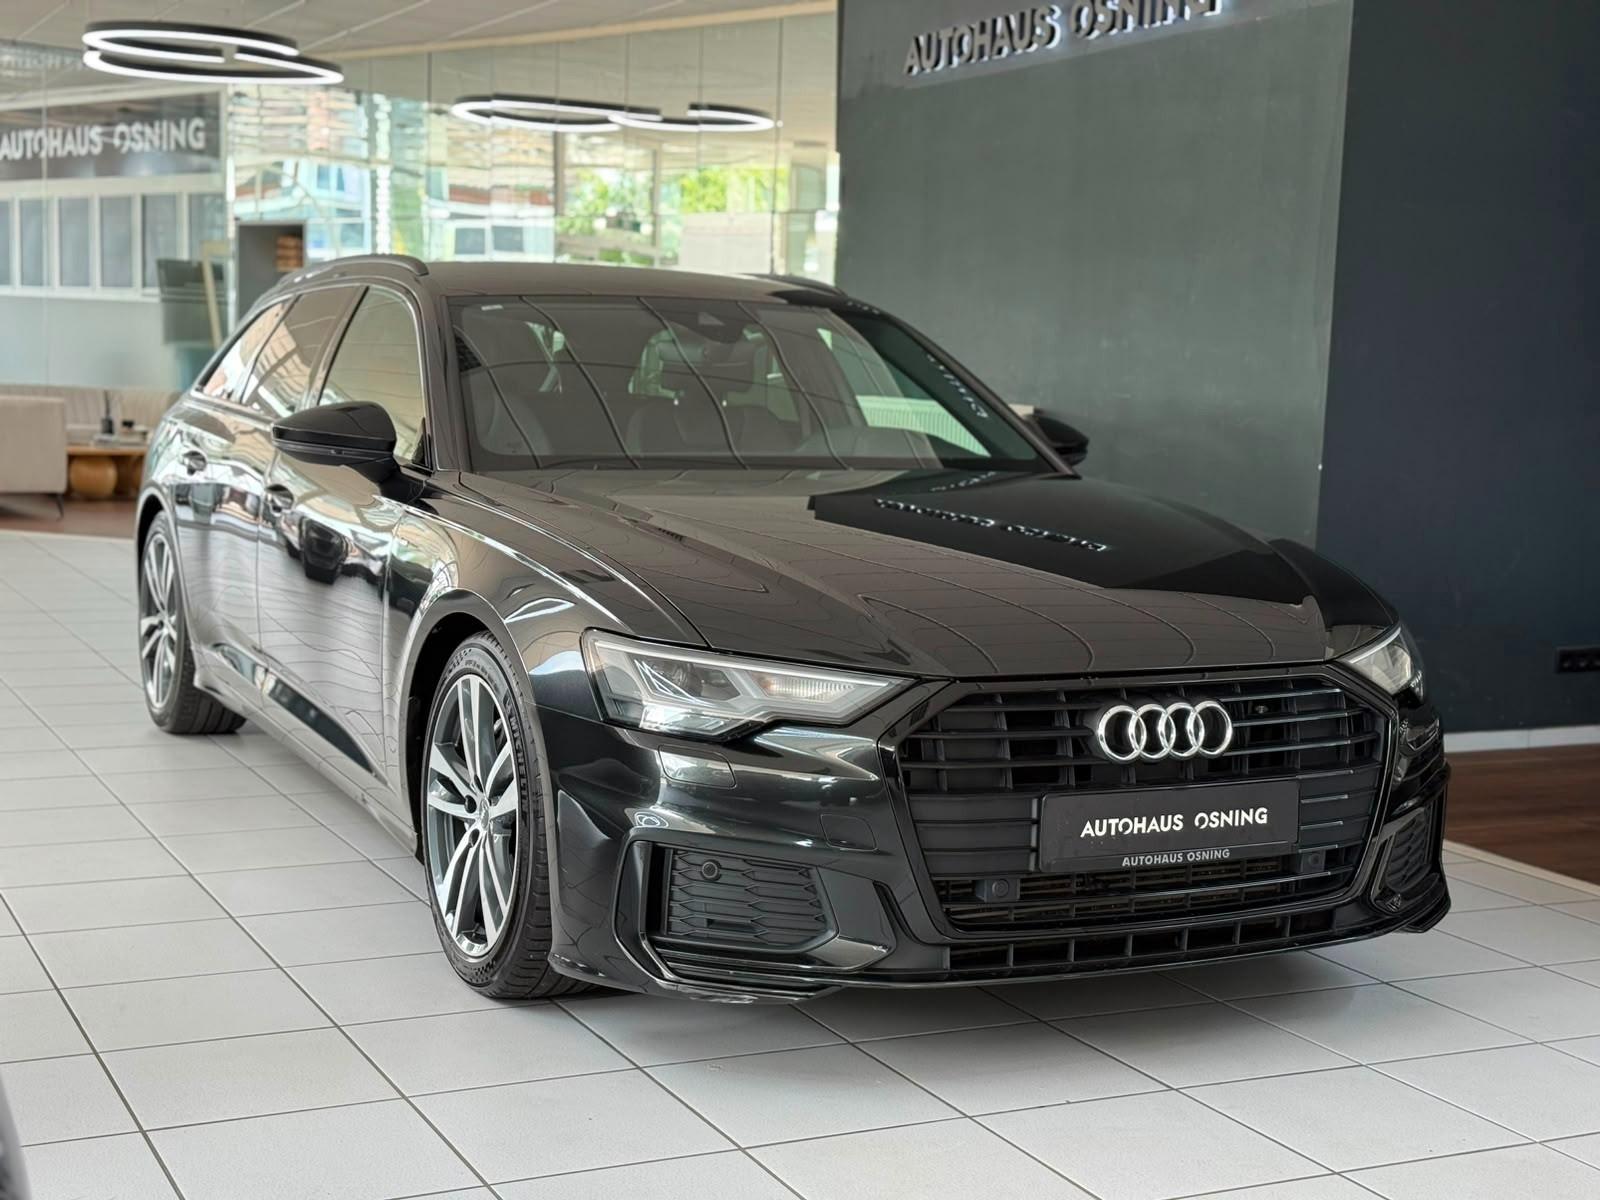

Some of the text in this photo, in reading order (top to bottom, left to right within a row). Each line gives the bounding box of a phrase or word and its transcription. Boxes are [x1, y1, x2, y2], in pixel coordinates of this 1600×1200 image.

[905, 4, 1061, 75] AUTOHAUS
[0, 117, 206, 160] AUTOHAUS OSNING
[1080, 807, 1268, 838] AUTOHAUS OSNING
[1122, 849, 1230, 867] AUTOHAUS OSNING
